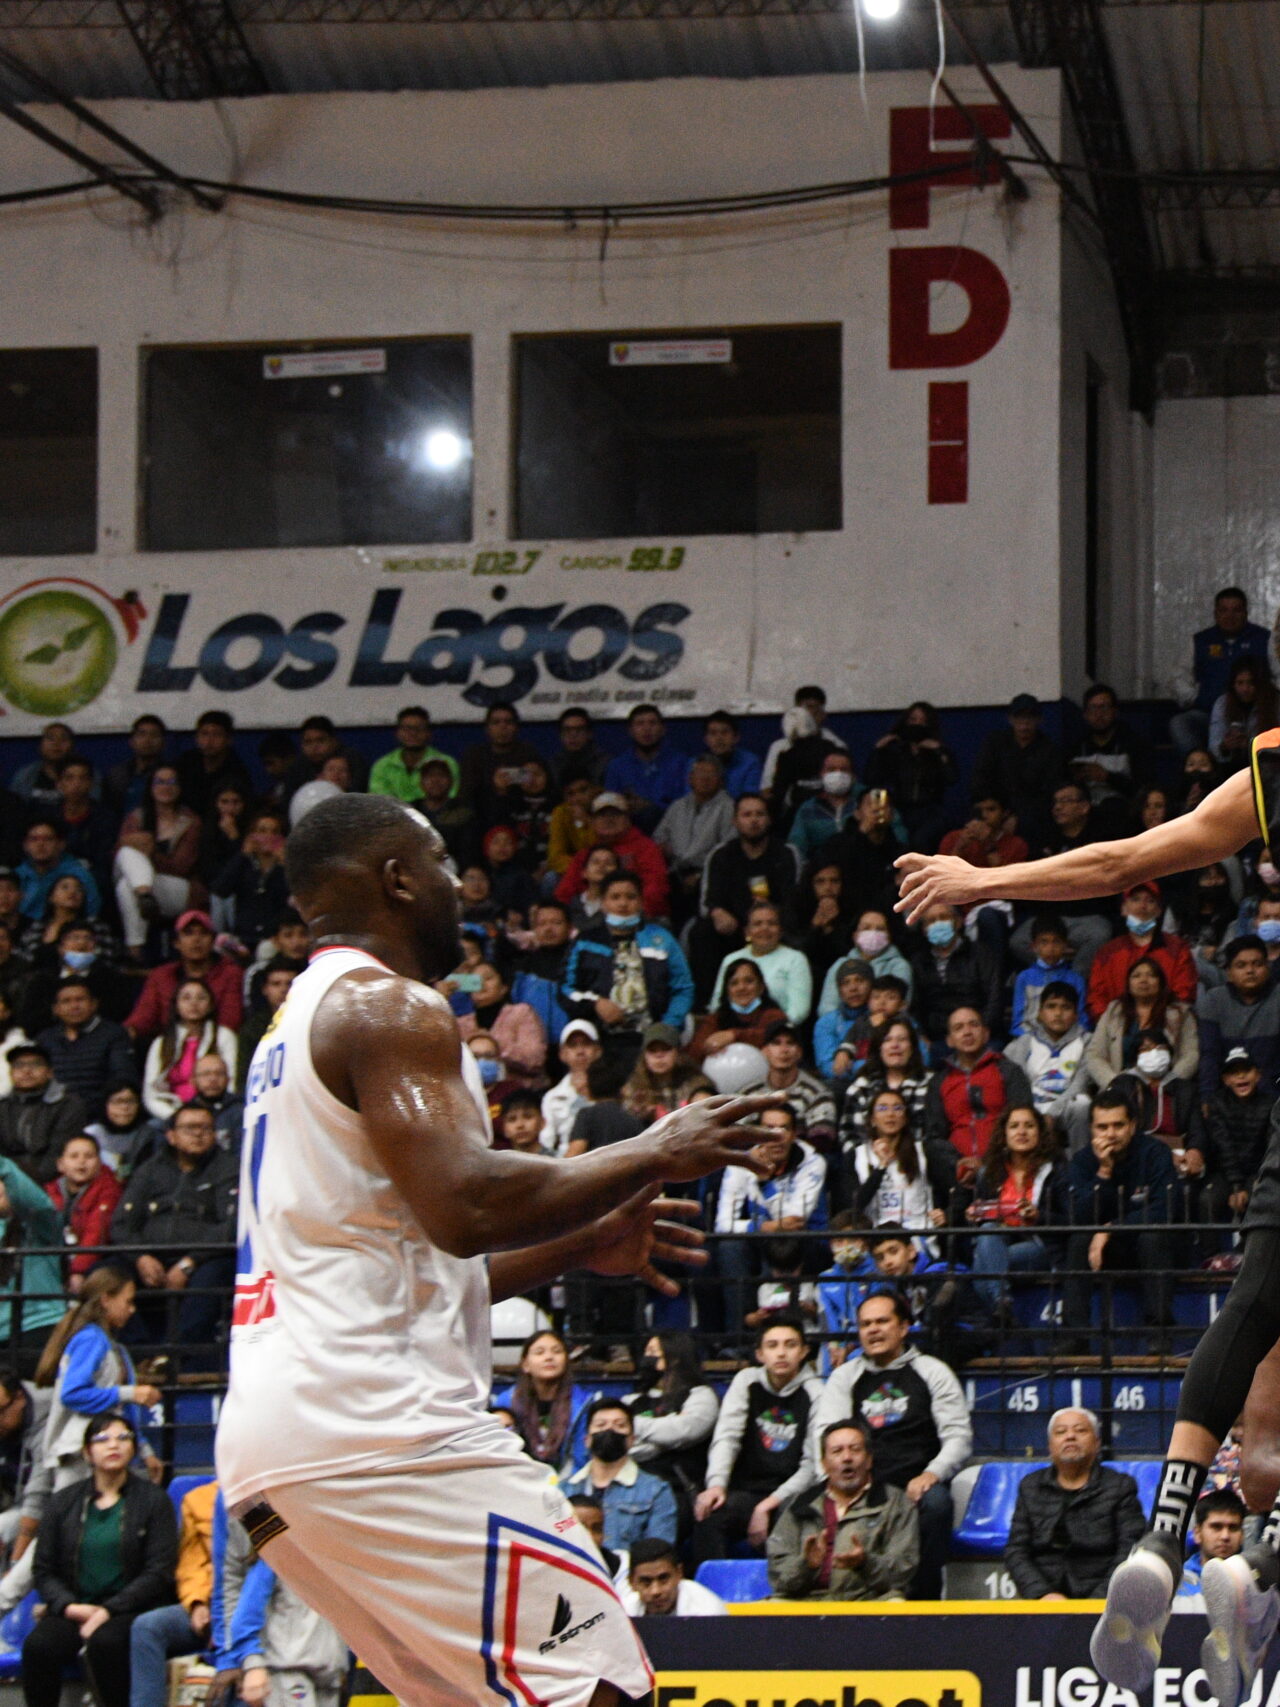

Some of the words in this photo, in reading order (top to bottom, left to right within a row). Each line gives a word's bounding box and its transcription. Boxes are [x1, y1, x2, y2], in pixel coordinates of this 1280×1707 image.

[1008, 1386, 1039, 1411] 45
[1114, 1385, 1145, 1410] 46
[984, 1571, 1017, 1599] 16
